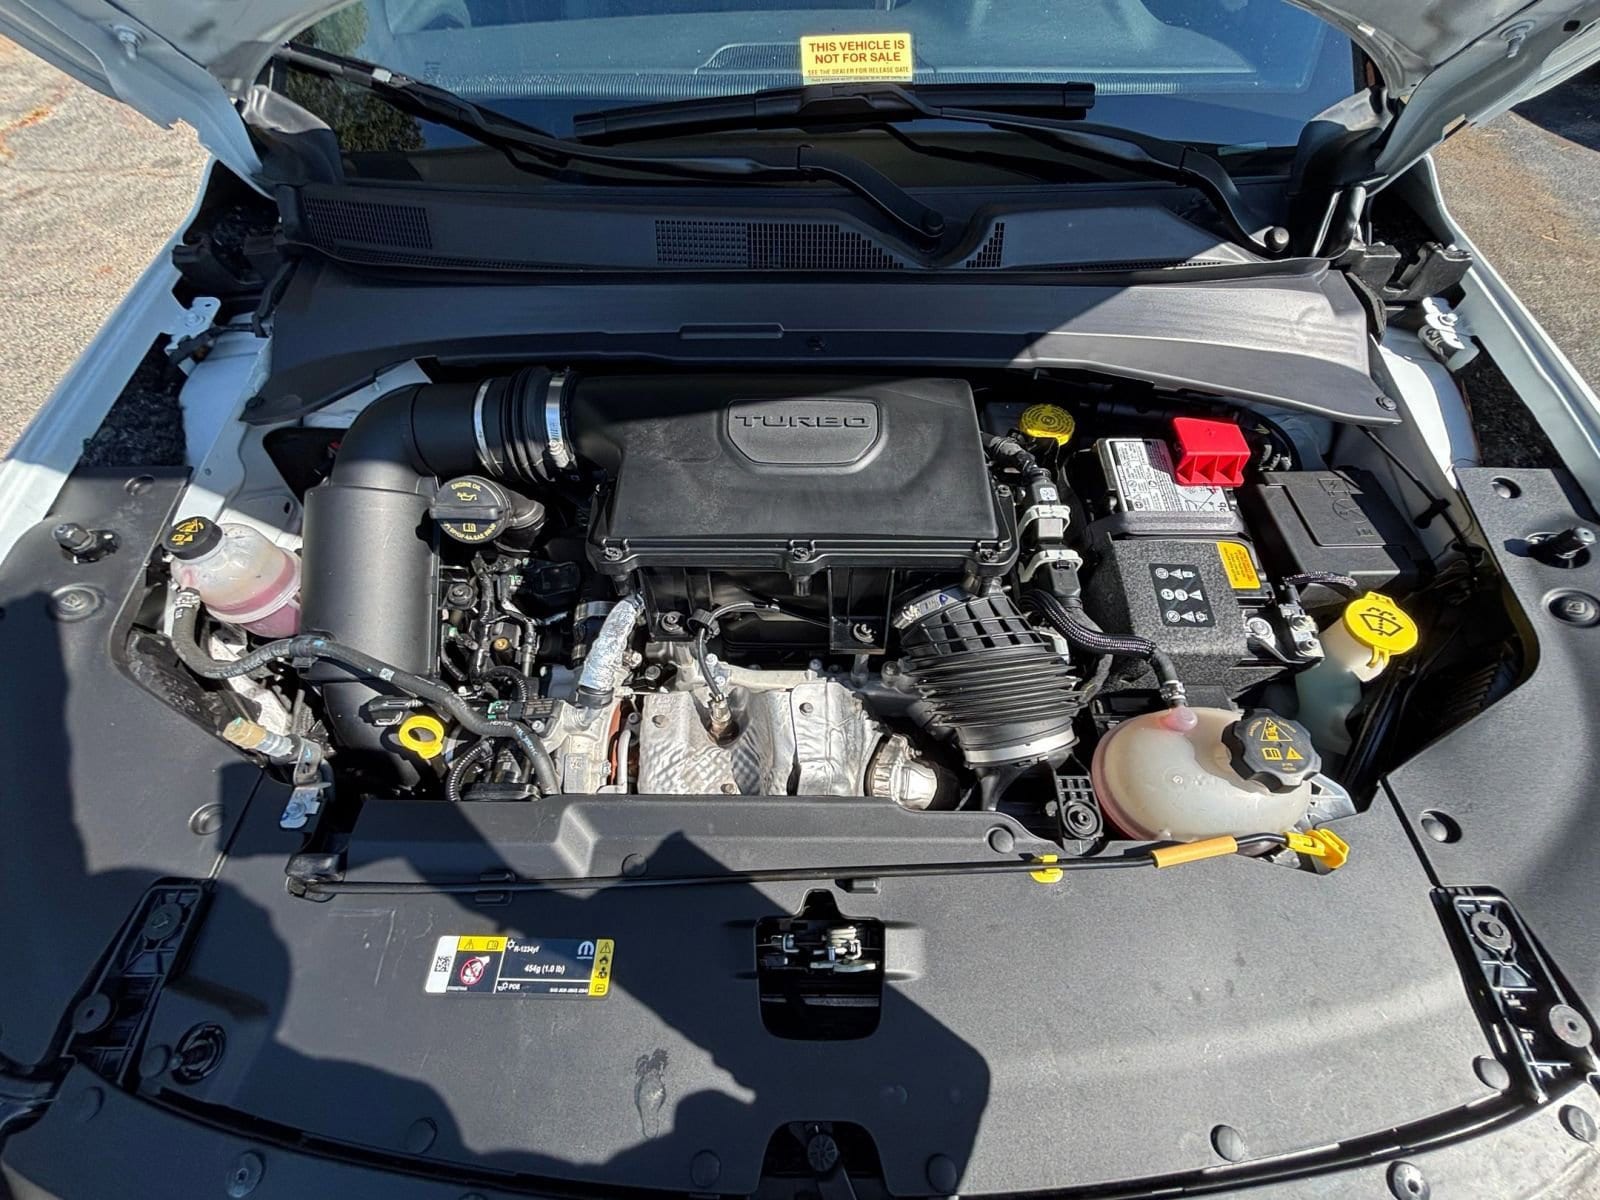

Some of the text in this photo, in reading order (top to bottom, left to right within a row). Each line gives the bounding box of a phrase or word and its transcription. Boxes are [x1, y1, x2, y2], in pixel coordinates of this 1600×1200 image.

[809, 40, 905, 52] THIS VEHICLE IS
[815, 52, 901, 64] NOT FOR SALE
[735, 415, 871, 428] TURBO
[524, 963, 541, 974] 454g
[555, 964, 566, 975] lb)
